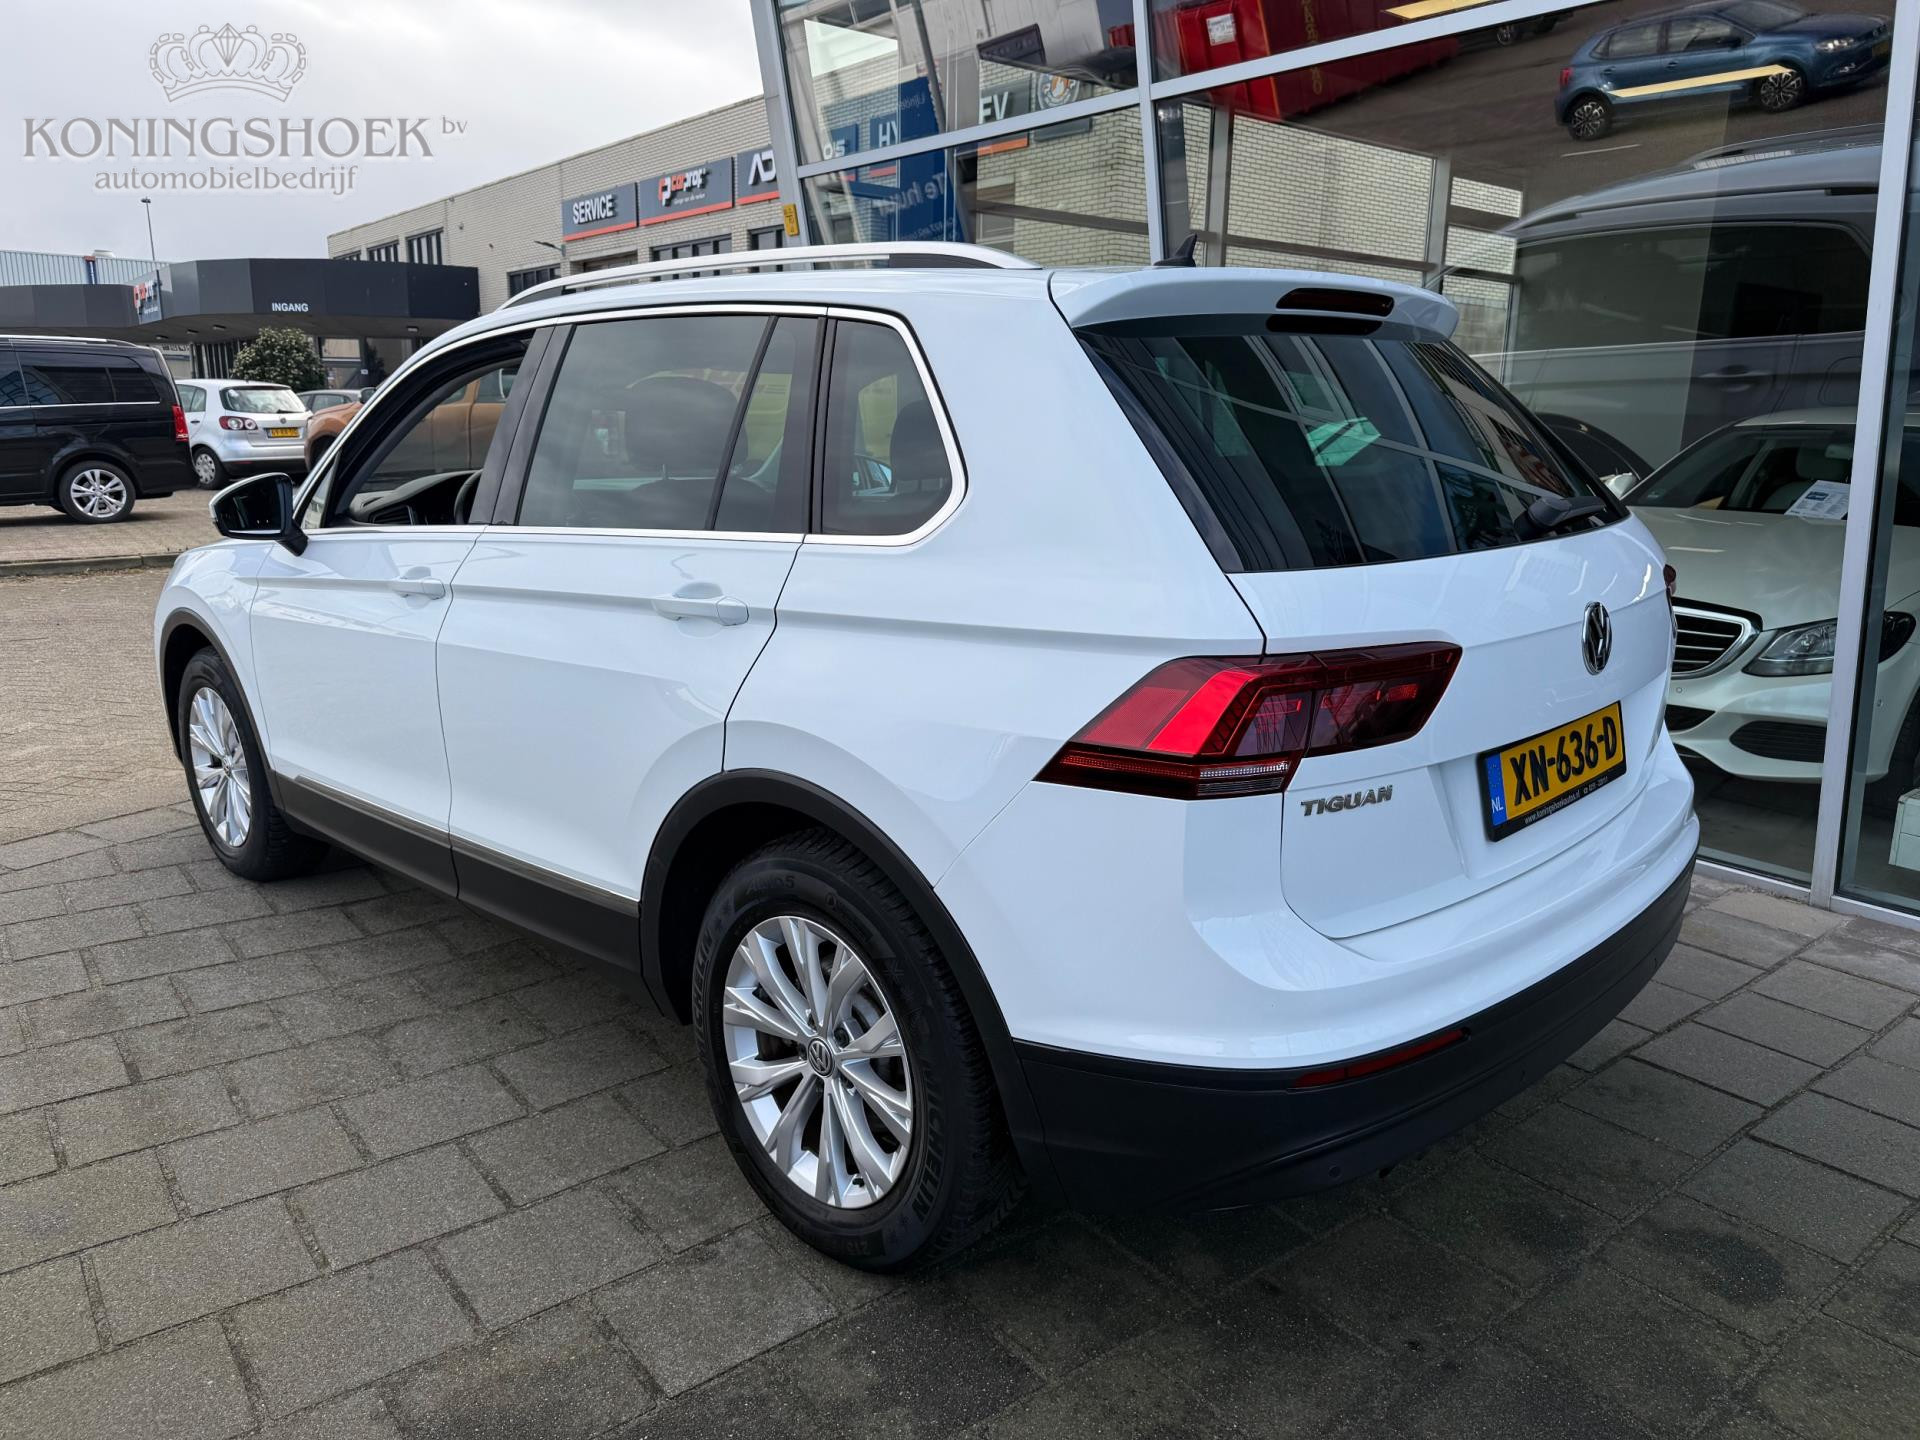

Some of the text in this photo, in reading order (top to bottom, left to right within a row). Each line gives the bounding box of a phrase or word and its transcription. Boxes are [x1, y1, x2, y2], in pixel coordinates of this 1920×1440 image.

[572, 193, 614, 225] SERVICE
[271, 302, 309, 312] INGANG
[1509, 715, 1618, 807] XN-636-D
[1300, 784, 1394, 817] TIGUAN
[1491, 796, 1504, 814] NL
